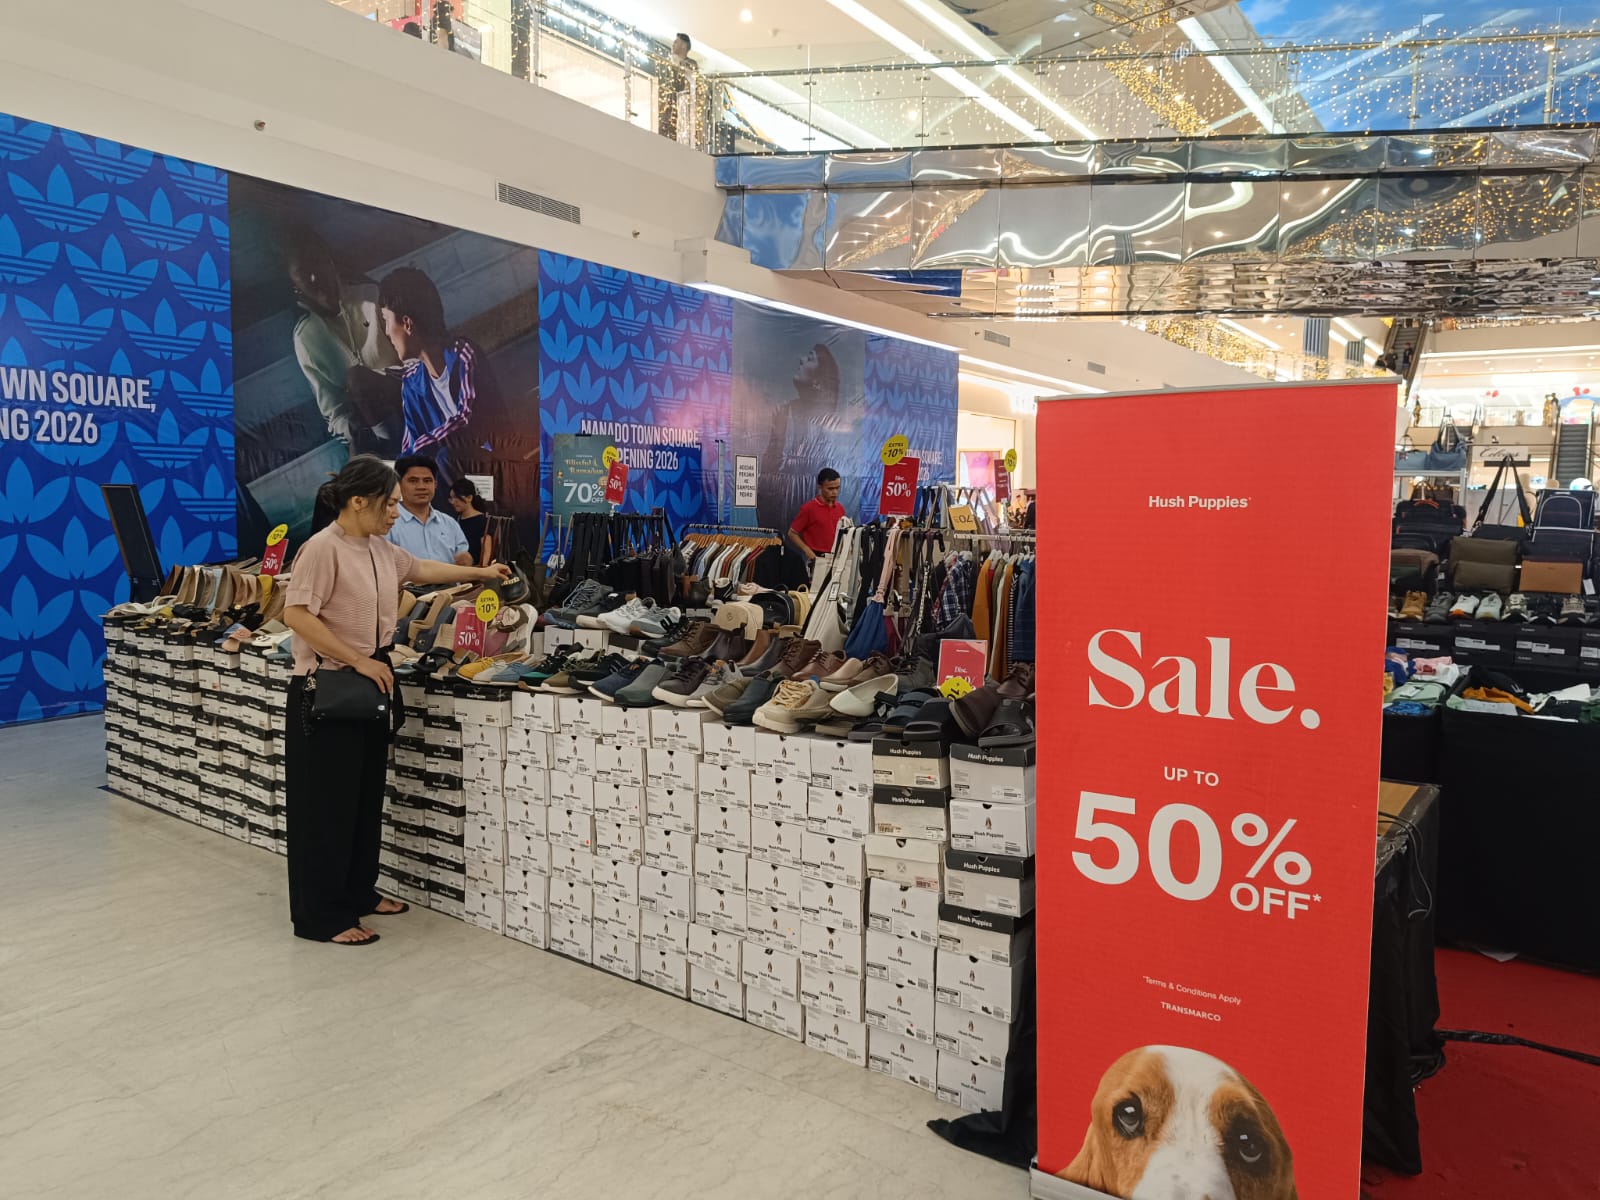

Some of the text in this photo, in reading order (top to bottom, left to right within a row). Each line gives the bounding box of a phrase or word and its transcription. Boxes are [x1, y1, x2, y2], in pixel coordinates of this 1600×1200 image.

[52, 371, 156, 412] SQUARE,
[34, 410, 98, 444] 2026
[581, 419, 701, 451] MANADO TOWN SQUARE,
[617, 447, 653, 469] PENING
[655, 450, 679, 470] 2026
[563, 482, 604, 503] 70%
[885, 481, 912, 497] 50%
[1148, 495, 1248, 511] Hush Puppies
[458, 631, 480, 646] 50%
[1087, 629, 1321, 729] Sale.
[982, 754, 1004, 762] Puppies
[1163, 766, 1220, 787] UP TO
[1071, 790, 1313, 901] 50%
[978, 864, 1000, 872] Puppies
[958, 914, 992, 928] Hush Puppies
[1168, 982, 1174, 990] &
[1176, 984, 1217, 1000] Conditions
[1218, 993, 1242, 1006] Apply
[1160, 1001, 1221, 1022] TRANSMARCO
